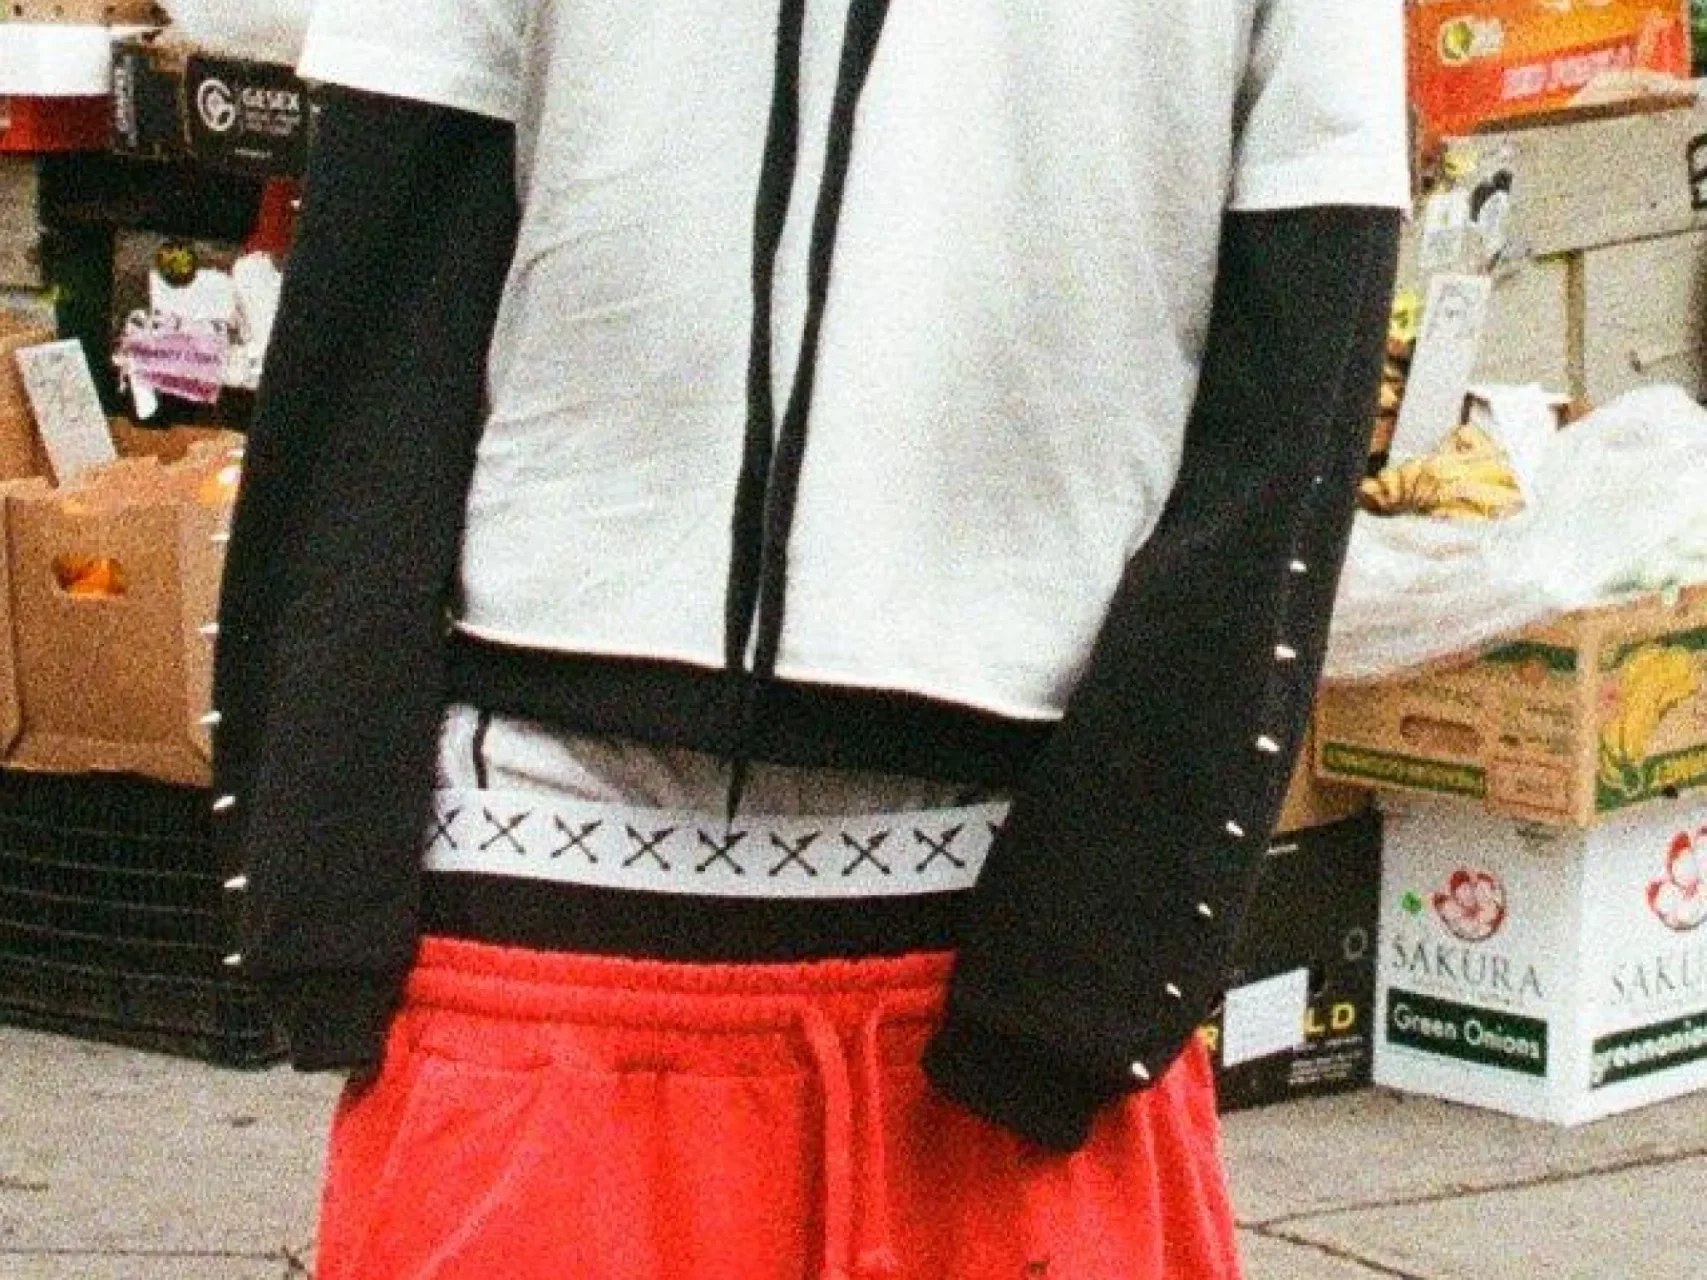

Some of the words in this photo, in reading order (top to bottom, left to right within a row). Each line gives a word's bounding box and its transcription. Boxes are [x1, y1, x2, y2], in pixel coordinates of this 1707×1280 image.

[1391, 937, 1543, 999] SAKURA
[1393, 1003, 1457, 1041] Green
[1463, 1019, 1540, 1060] Onions
